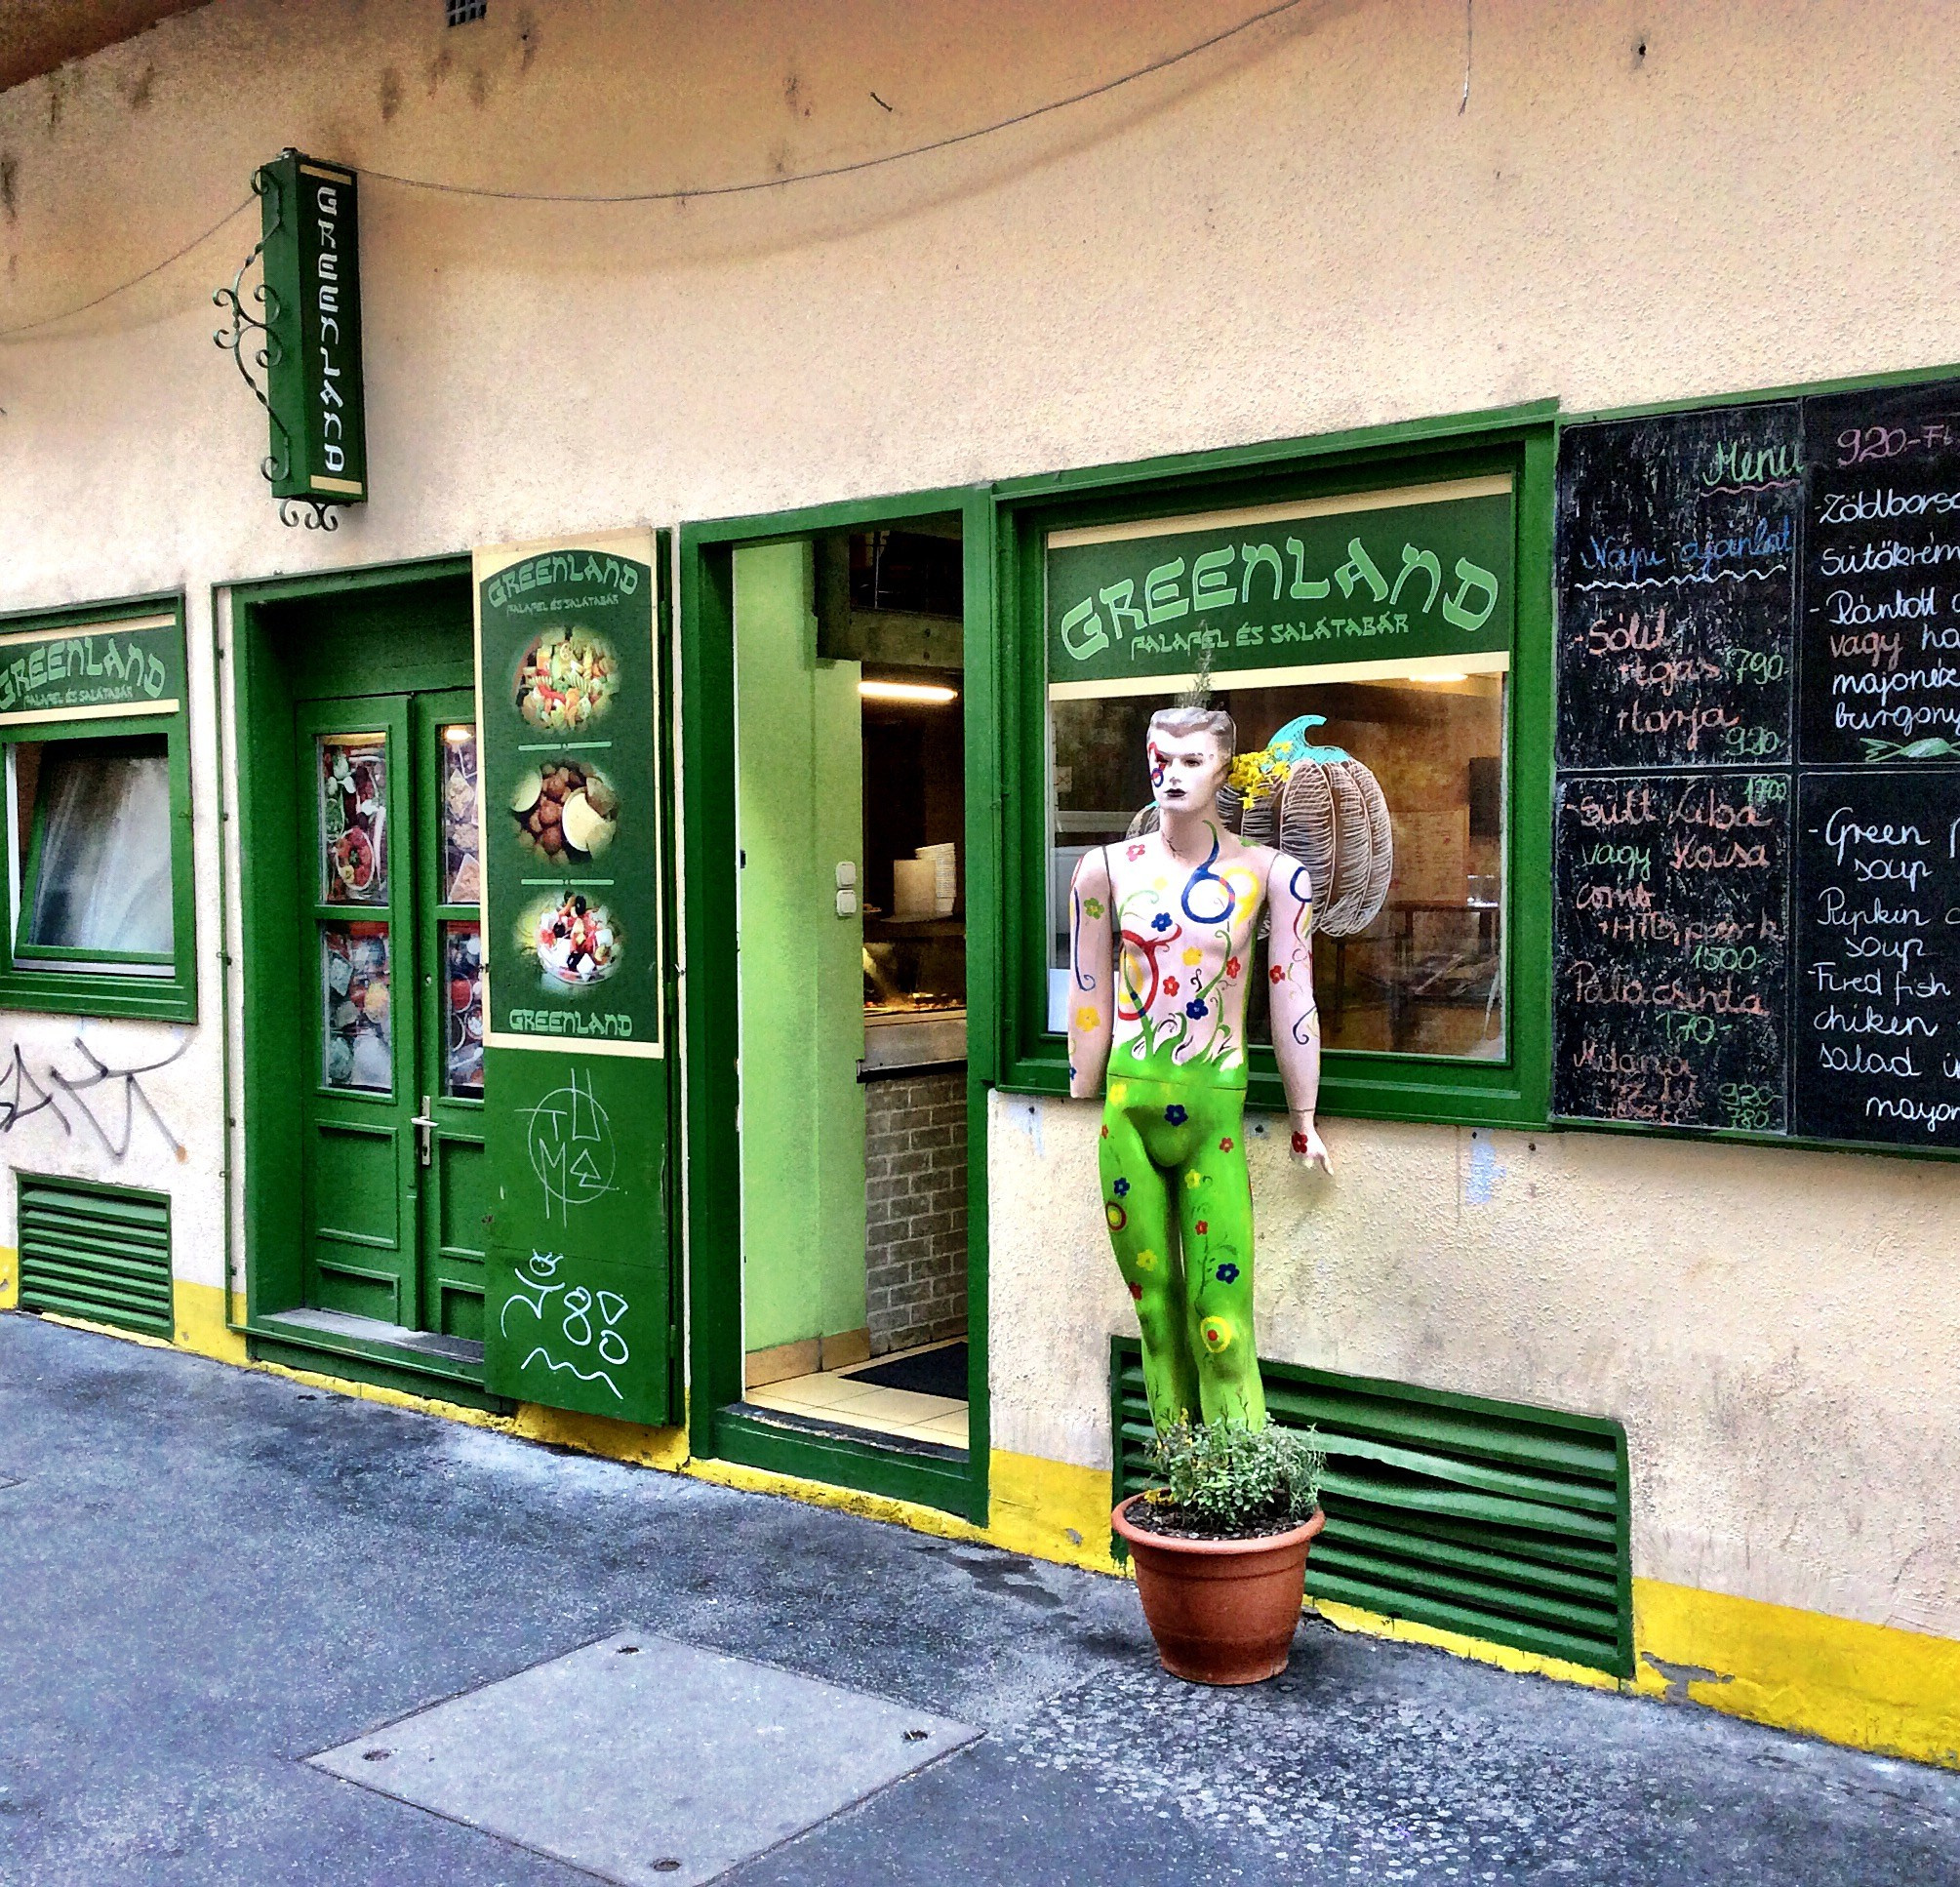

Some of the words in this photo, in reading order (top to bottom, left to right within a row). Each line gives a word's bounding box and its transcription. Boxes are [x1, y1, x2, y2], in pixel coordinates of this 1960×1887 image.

[317, 185, 344, 472] GREENLAND
[489, 554, 638, 607] GREENLAND
[1061, 537, 1499, 661] GREENLAND
[1132, 628, 1229, 661] FALAFEL
[1236, 622, 1263, 646] ÉS
[1270, 611, 1410, 644] SALÁTABÁR
[1830, 632, 1903, 671] vagy
[1577, 843, 1651, 881] vagy
[1855, 859, 1933, 892] soup
[1845, 937, 1933, 972] soup
[1894, 971, 1951, 1006] fish
[509, 1009, 632, 1036] GREENLAND
[1814, 1004, 1939, 1036] chiken
[1820, 1043, 1923, 1077] salad
